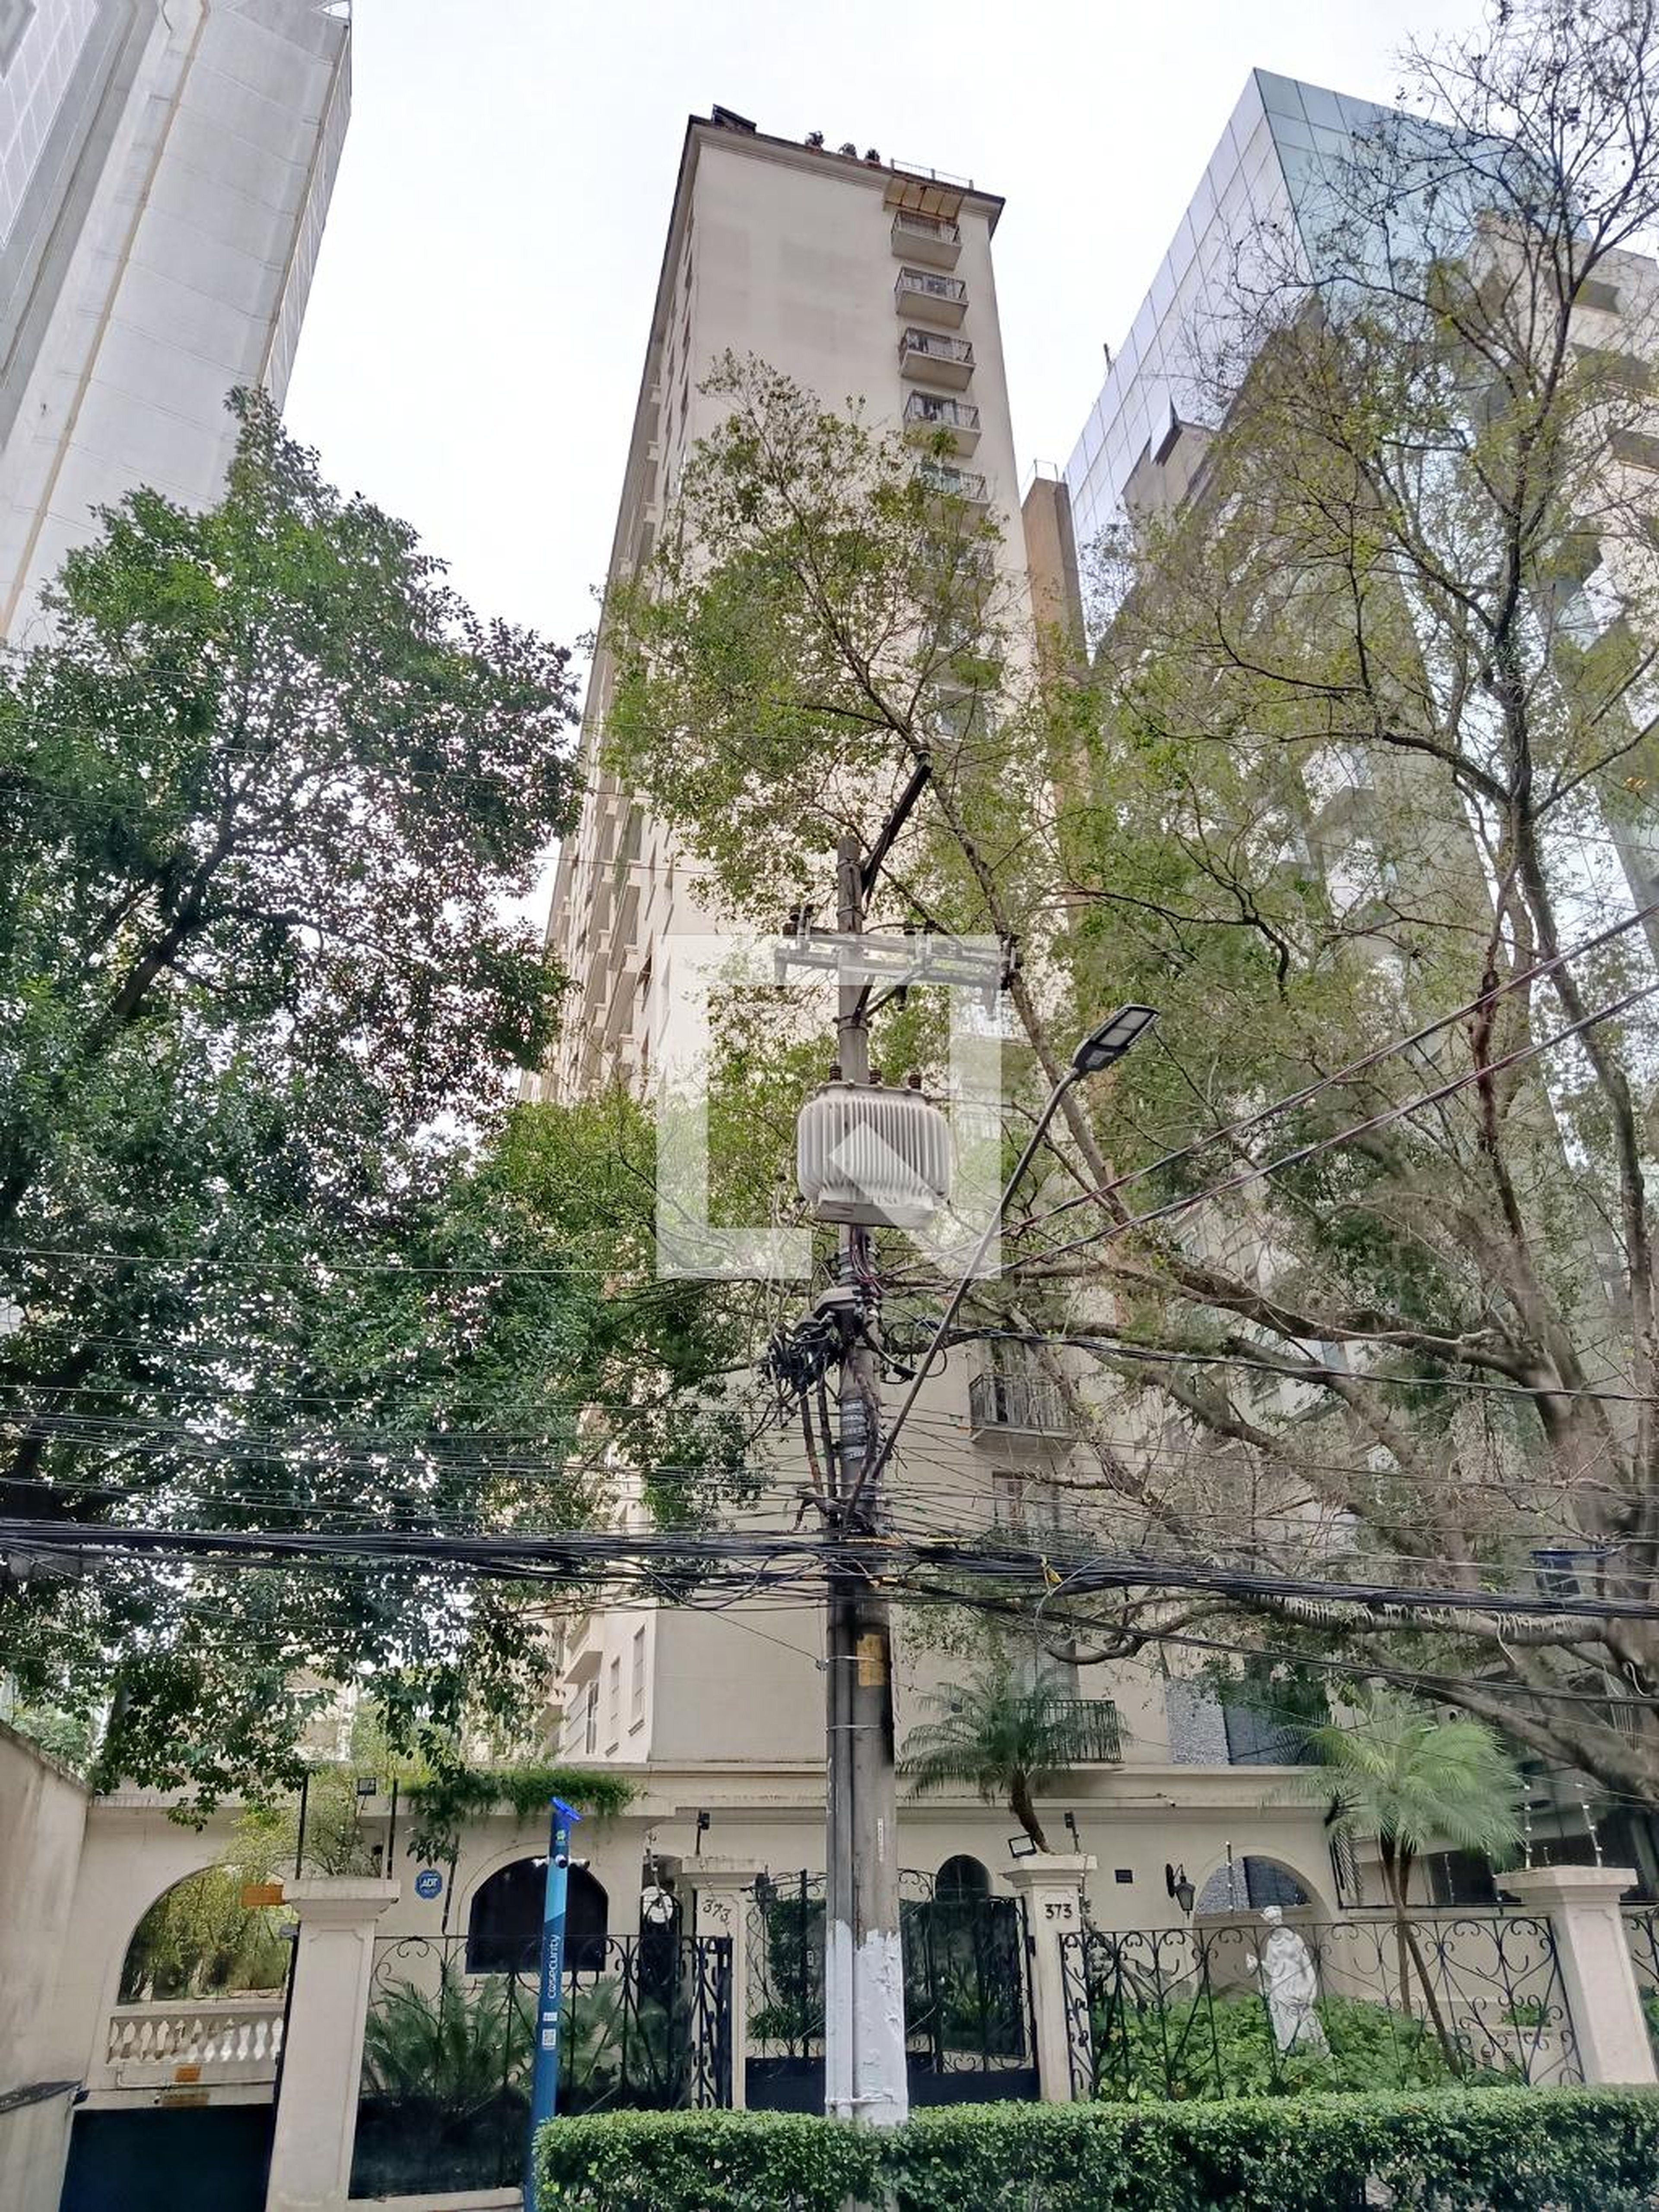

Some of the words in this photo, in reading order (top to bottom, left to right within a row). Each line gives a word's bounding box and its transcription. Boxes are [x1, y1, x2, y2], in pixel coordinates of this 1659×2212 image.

[420, 1878, 438, 1888] ADT
[702, 1899, 732, 1922] 373
[1045, 1903, 1072, 1919] 373
